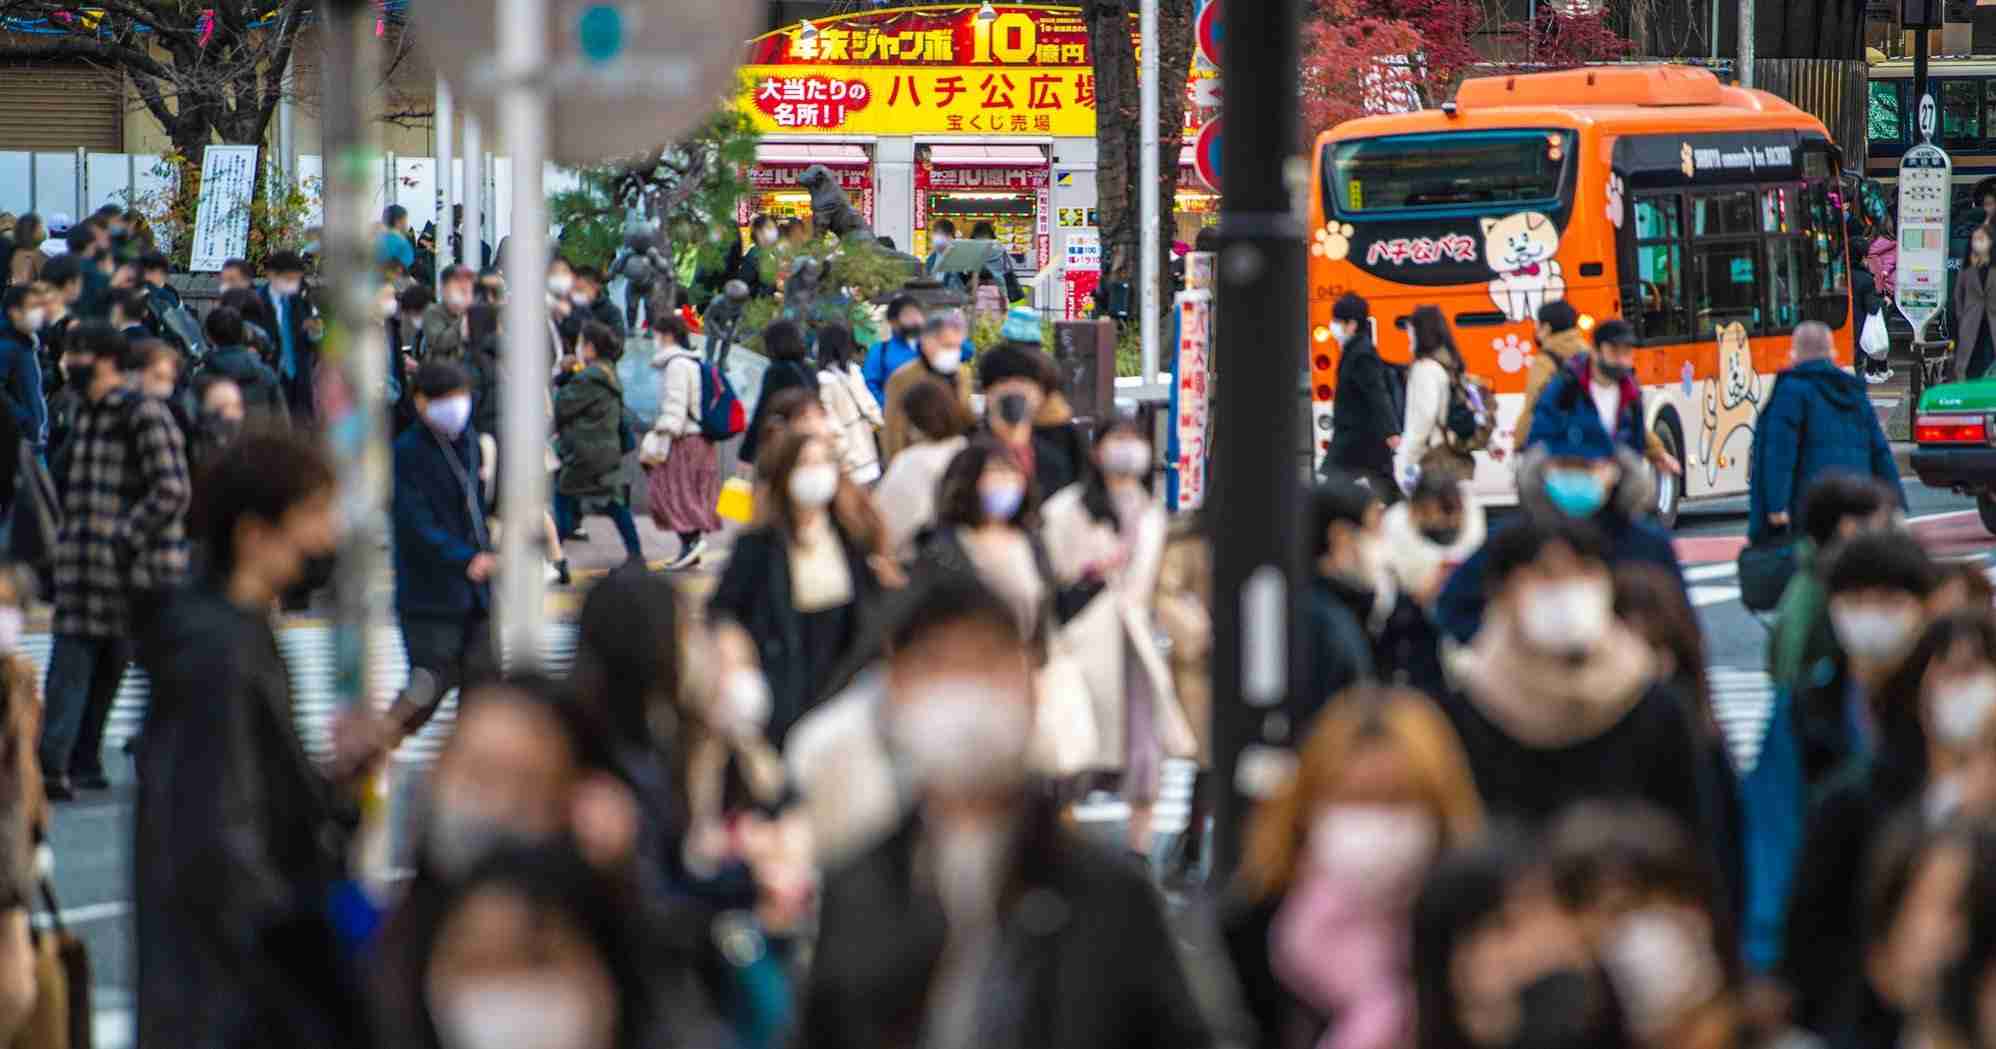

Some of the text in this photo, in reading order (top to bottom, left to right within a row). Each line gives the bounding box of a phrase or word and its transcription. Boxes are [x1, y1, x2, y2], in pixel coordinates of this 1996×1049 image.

[789, 28, 953, 61] 年末ジャンボ
[759, 78, 866, 101] 大当たりの
[887, 74, 1096, 110] ハチ公広場
[946, 114, 1050, 131] 宝くじ売場
[1921, 103, 1935, 130] 27
[1366, 233, 1478, 265] ハチ公バス
